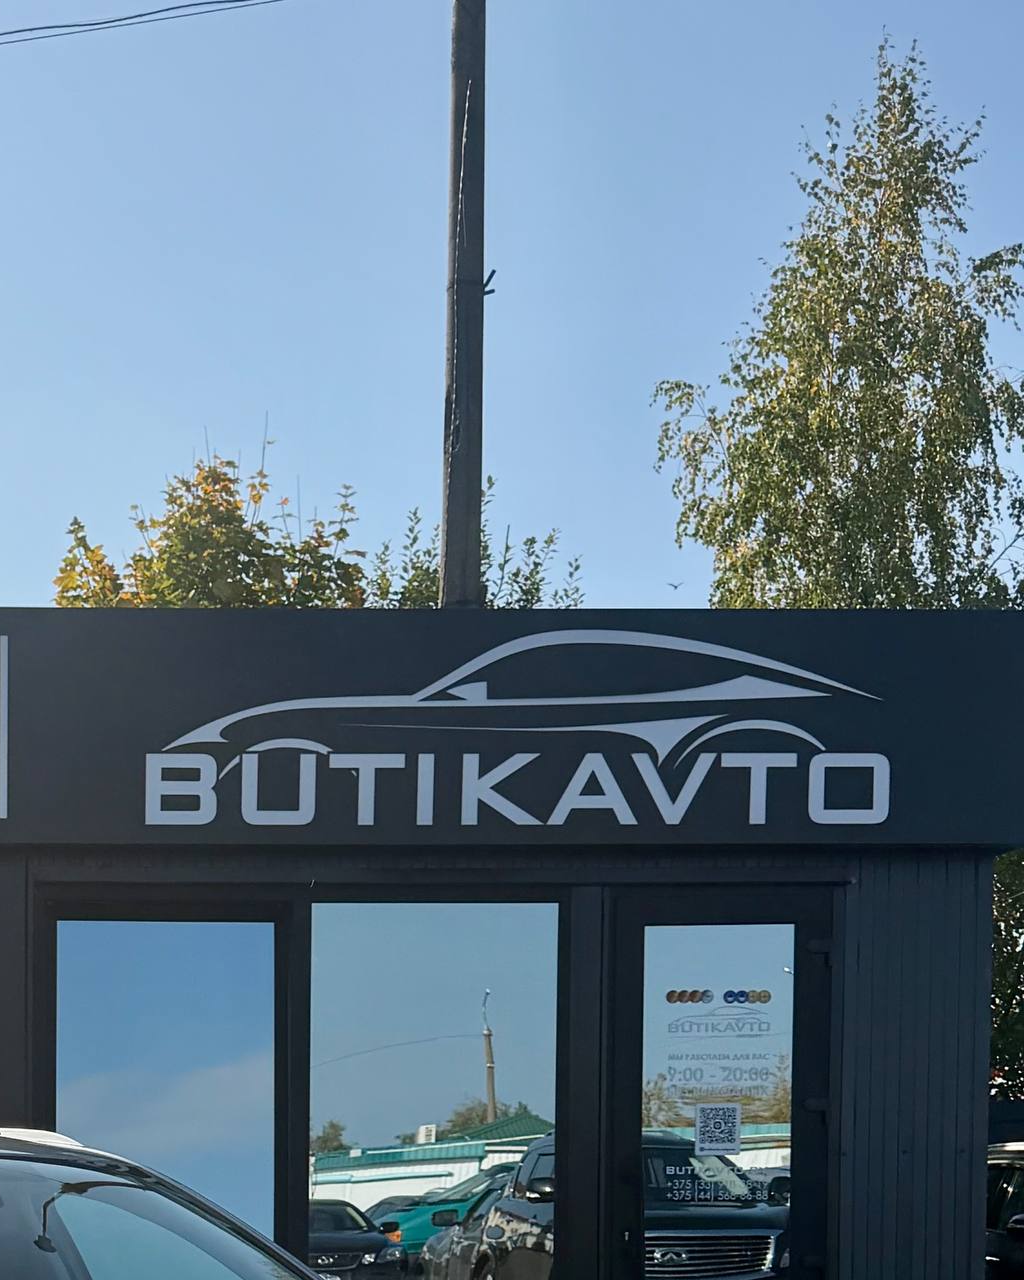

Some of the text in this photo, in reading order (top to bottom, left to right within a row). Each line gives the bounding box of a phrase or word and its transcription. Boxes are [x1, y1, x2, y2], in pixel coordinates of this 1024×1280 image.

[144, 751, 891, 826] BUTIKAVTO
[667, 1021, 771, 1033] BUTIKAVTO
[667, 1066, 704, 1082] 9:00
[720, 1066, 770, 1082] 20:00
[666, 1180, 692, 1190] +375
[666, 1190, 692, 1201] +375
